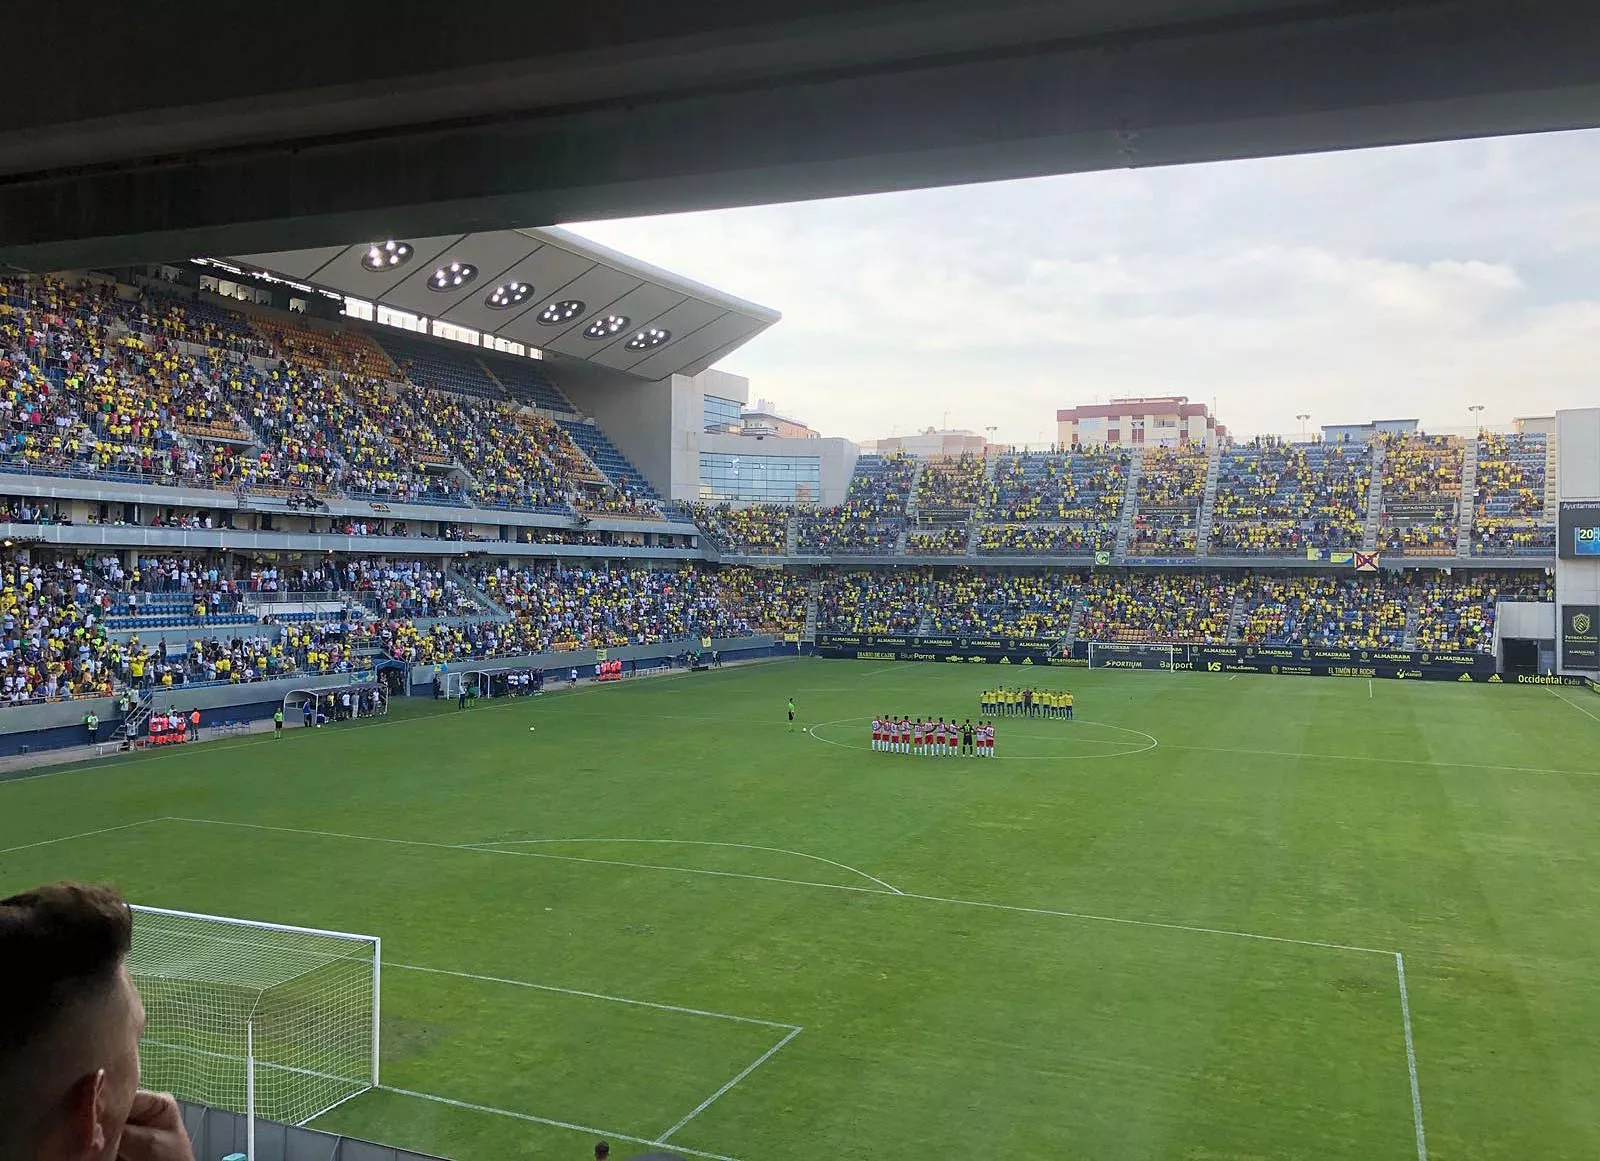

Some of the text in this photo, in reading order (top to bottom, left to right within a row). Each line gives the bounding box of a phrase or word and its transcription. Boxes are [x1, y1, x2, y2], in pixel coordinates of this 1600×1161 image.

[1580, 529, 1594, 539] 20
[1102, 660, 1142, 668] SPORTIUM
[1159, 660, 1193, 669] Bayport
[1207, 661, 1222, 672] VS
[1518, 674, 1562, 685] Occidental
